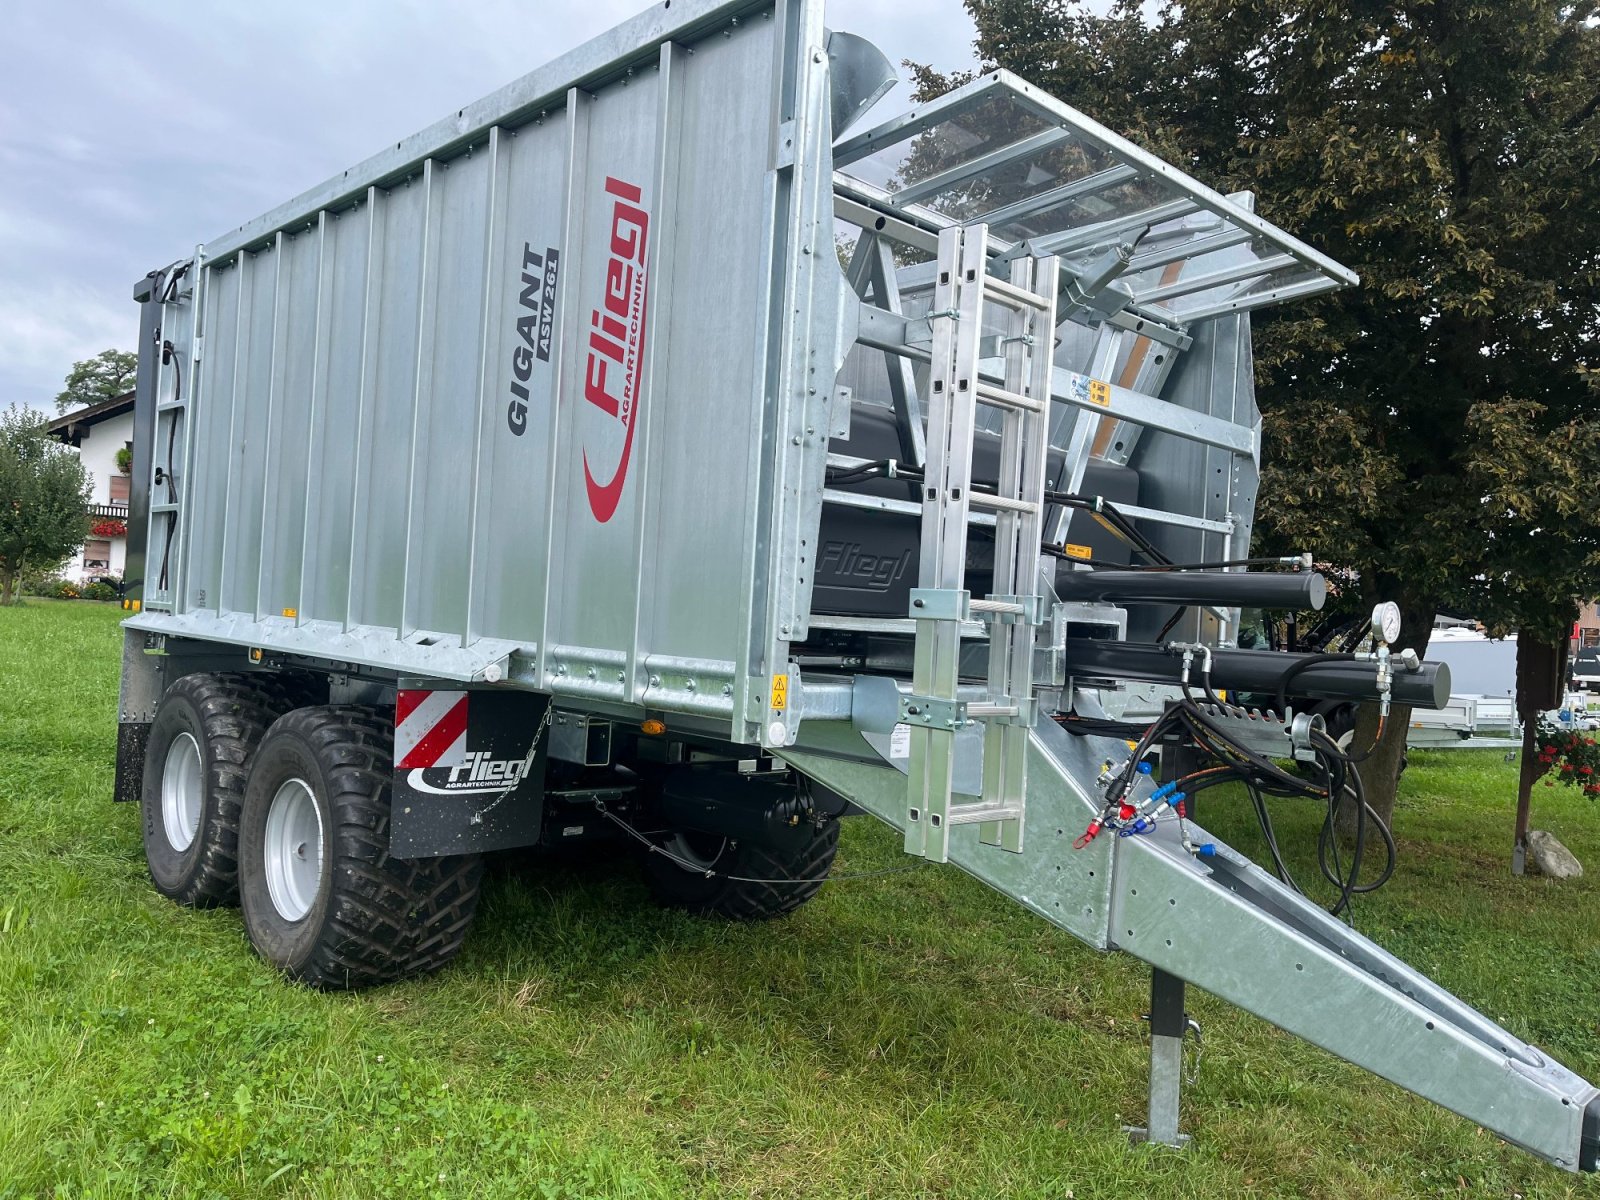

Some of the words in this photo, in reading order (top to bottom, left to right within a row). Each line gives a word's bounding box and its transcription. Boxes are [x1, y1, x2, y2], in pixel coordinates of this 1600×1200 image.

[508, 242, 543, 436] GIGANT
[540, 302, 552, 353] ASW
[546, 259, 557, 300] 261
[585, 176, 649, 418] Fliegl
[621, 272, 643, 427] AGRARTECHNIK
[815, 540, 911, 587] Fliegl
[445, 780, 501, 789] AGRARTECHNIK
[448, 750, 536, 786] Fliegl
